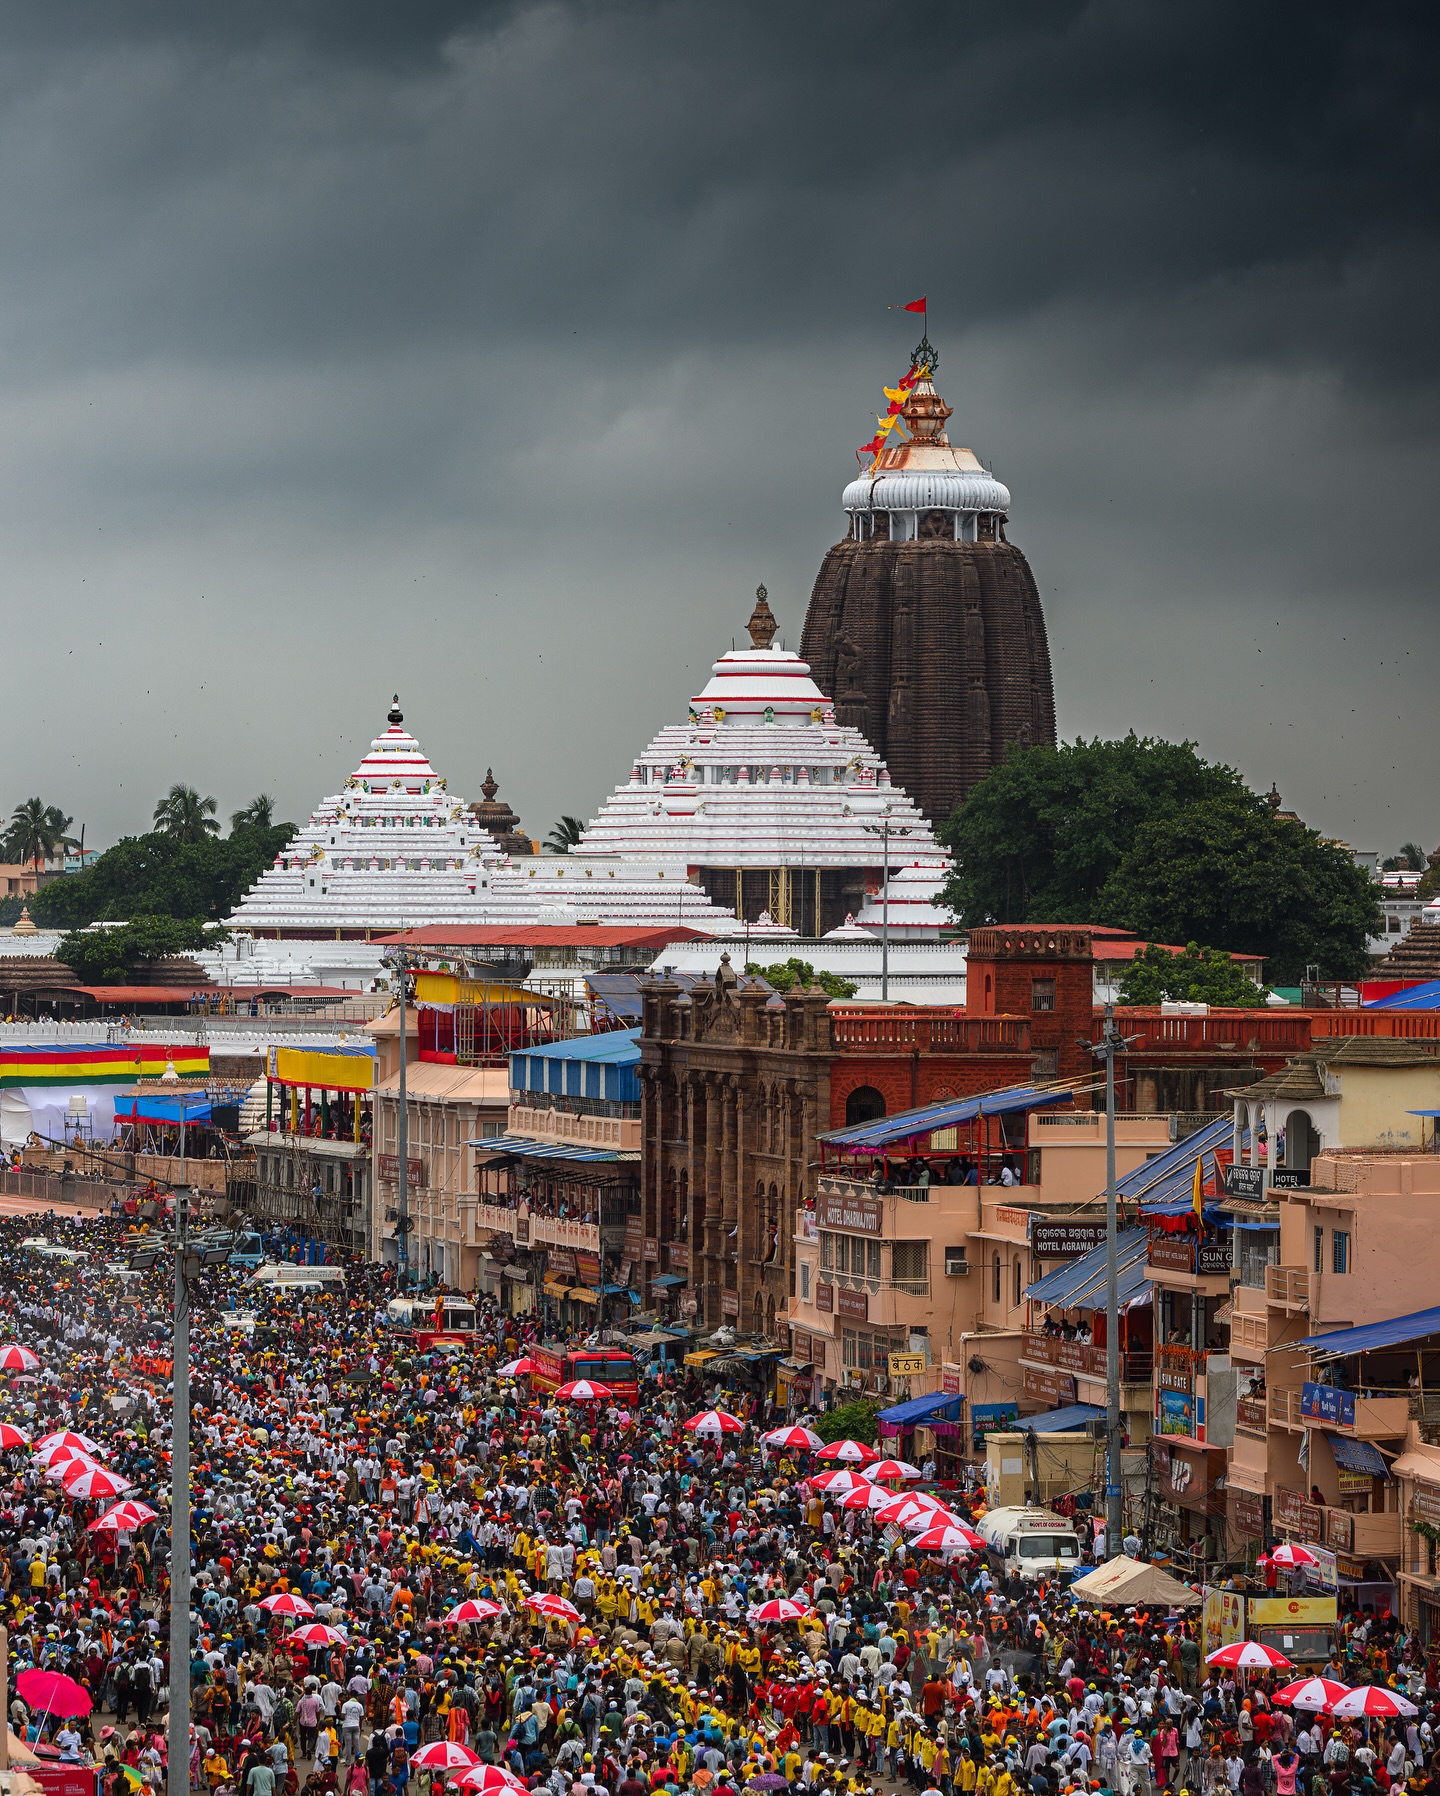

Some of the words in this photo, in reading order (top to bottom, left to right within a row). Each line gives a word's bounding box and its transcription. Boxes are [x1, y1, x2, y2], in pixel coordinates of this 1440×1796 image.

[1275, 1175, 1298, 1183] HOTEL
[827, 1207, 843, 1225] HOTEL
[1037, 1241, 1060, 1251] HOTEL
[1061, 1241, 1094, 1251] AGRAWAL
[1202, 1252, 1223, 1262] SUN
[1162, 1373, 1172, 1385] SUN
[1173, 1376, 1187, 1389] GATE
